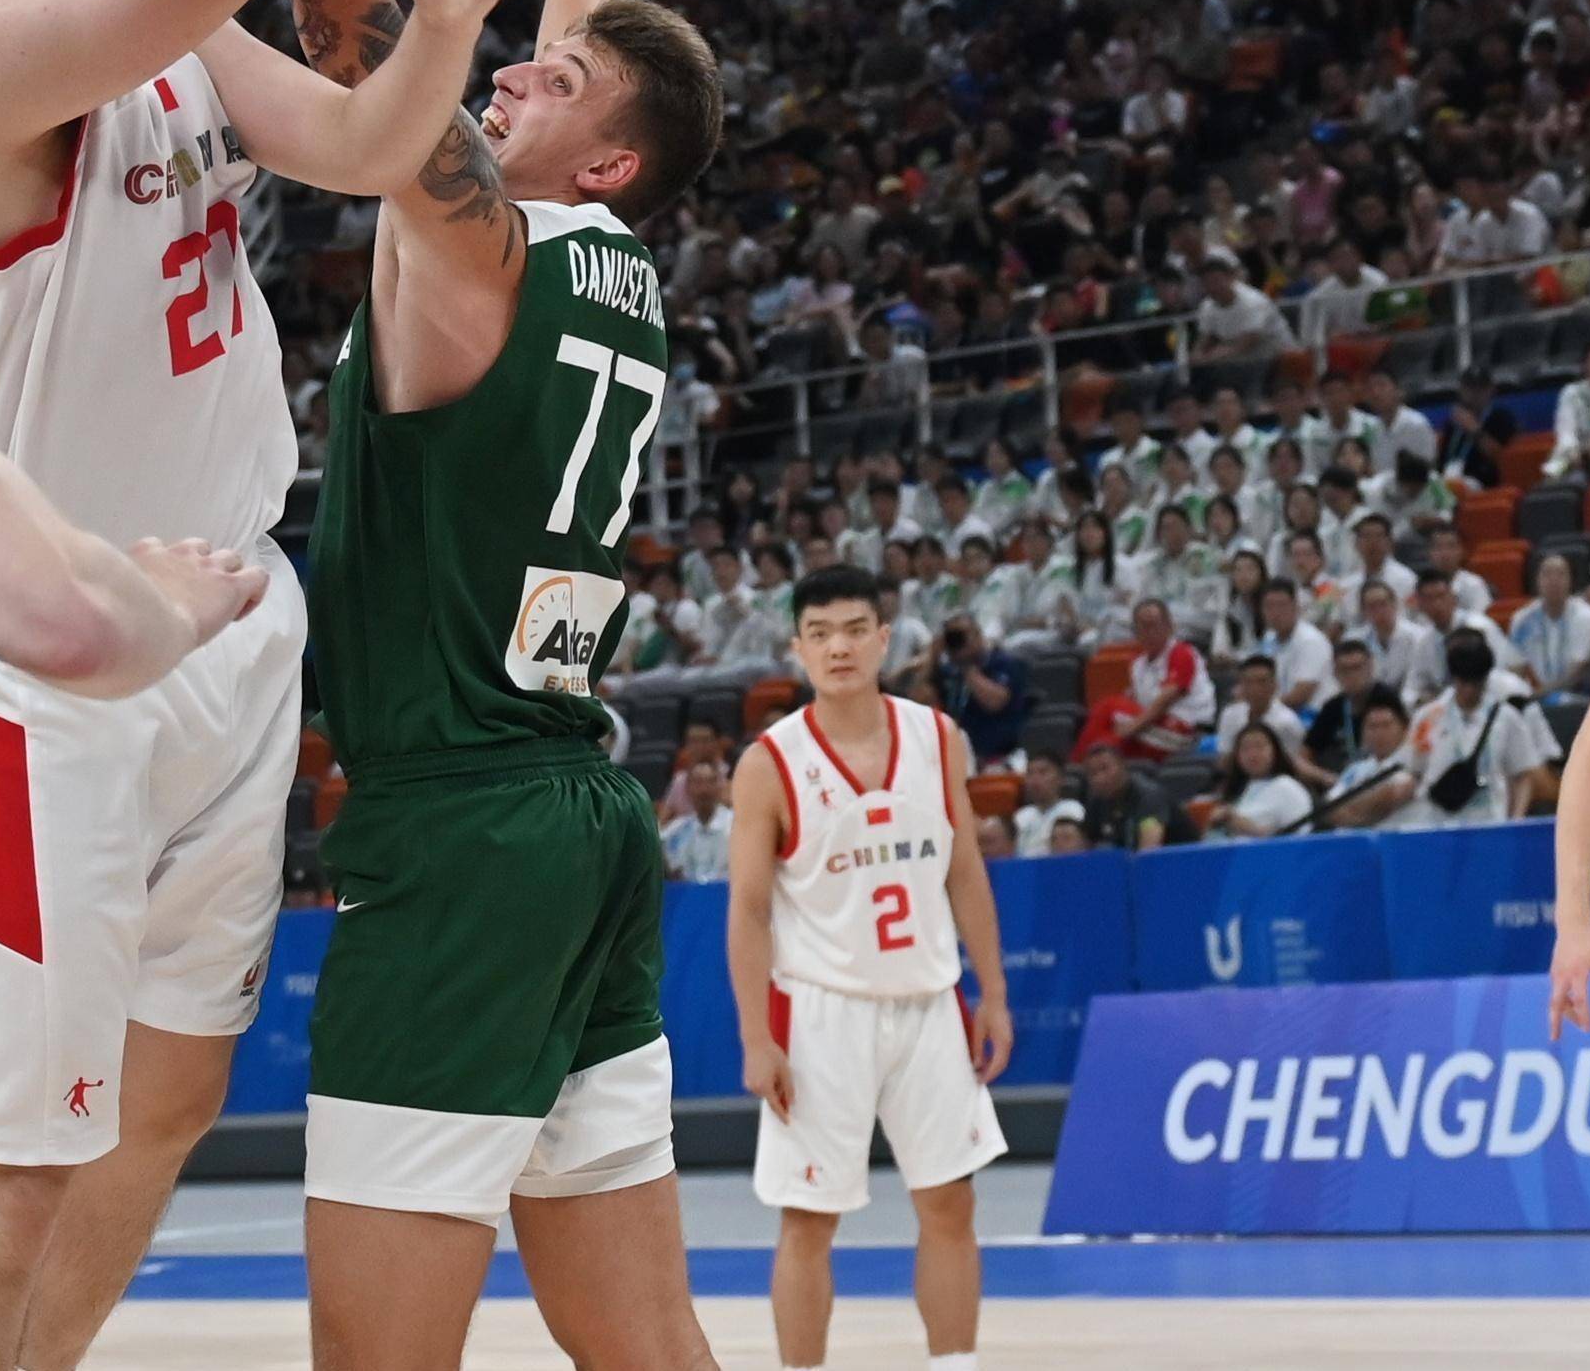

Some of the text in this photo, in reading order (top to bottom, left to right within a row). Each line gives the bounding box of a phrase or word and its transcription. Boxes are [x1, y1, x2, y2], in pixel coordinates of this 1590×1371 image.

[546, 333, 667, 549] 77
[825, 838, 938, 874] CHINA
[872, 883, 916, 952] 2
